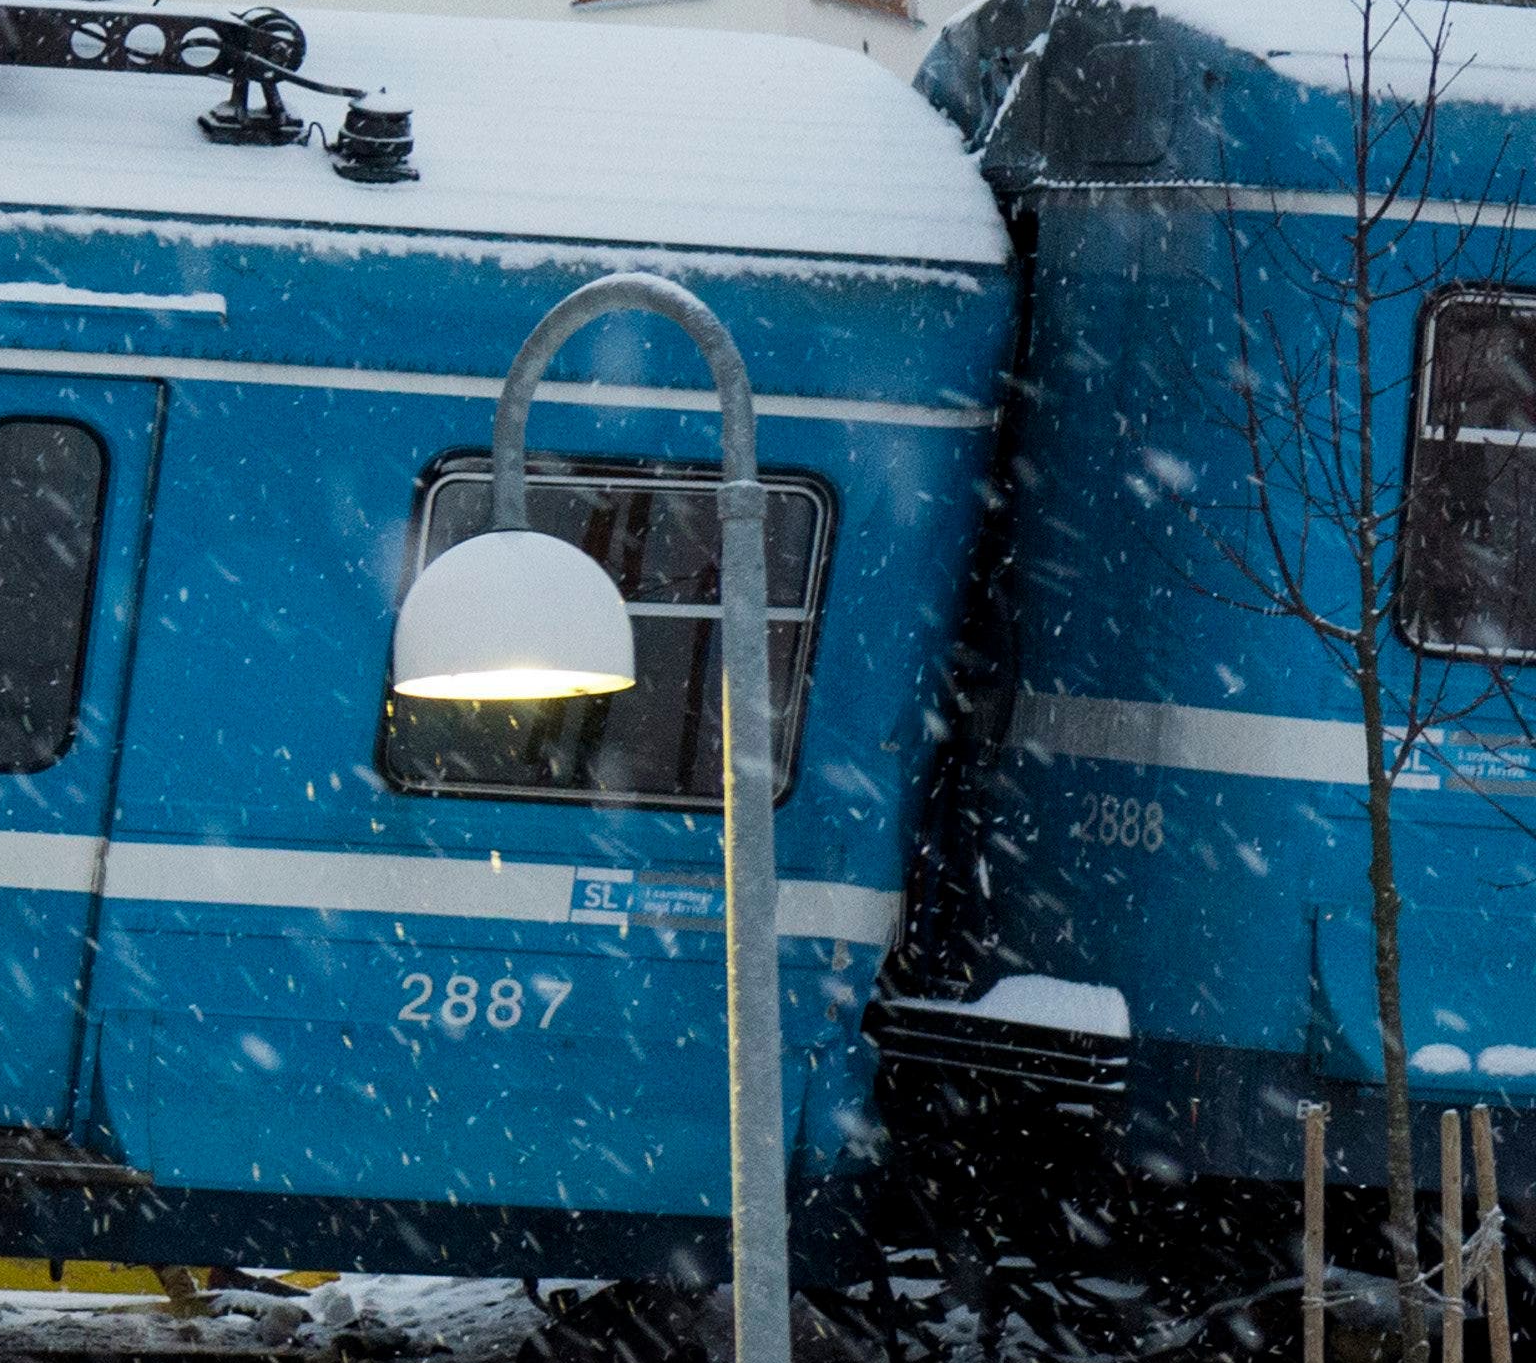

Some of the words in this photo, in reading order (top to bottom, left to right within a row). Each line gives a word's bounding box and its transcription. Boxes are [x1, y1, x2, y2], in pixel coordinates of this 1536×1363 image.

[1079, 791, 1165, 853] 2888
[583, 882, 618, 910] SL
[398, 973, 573, 1030] 2887
